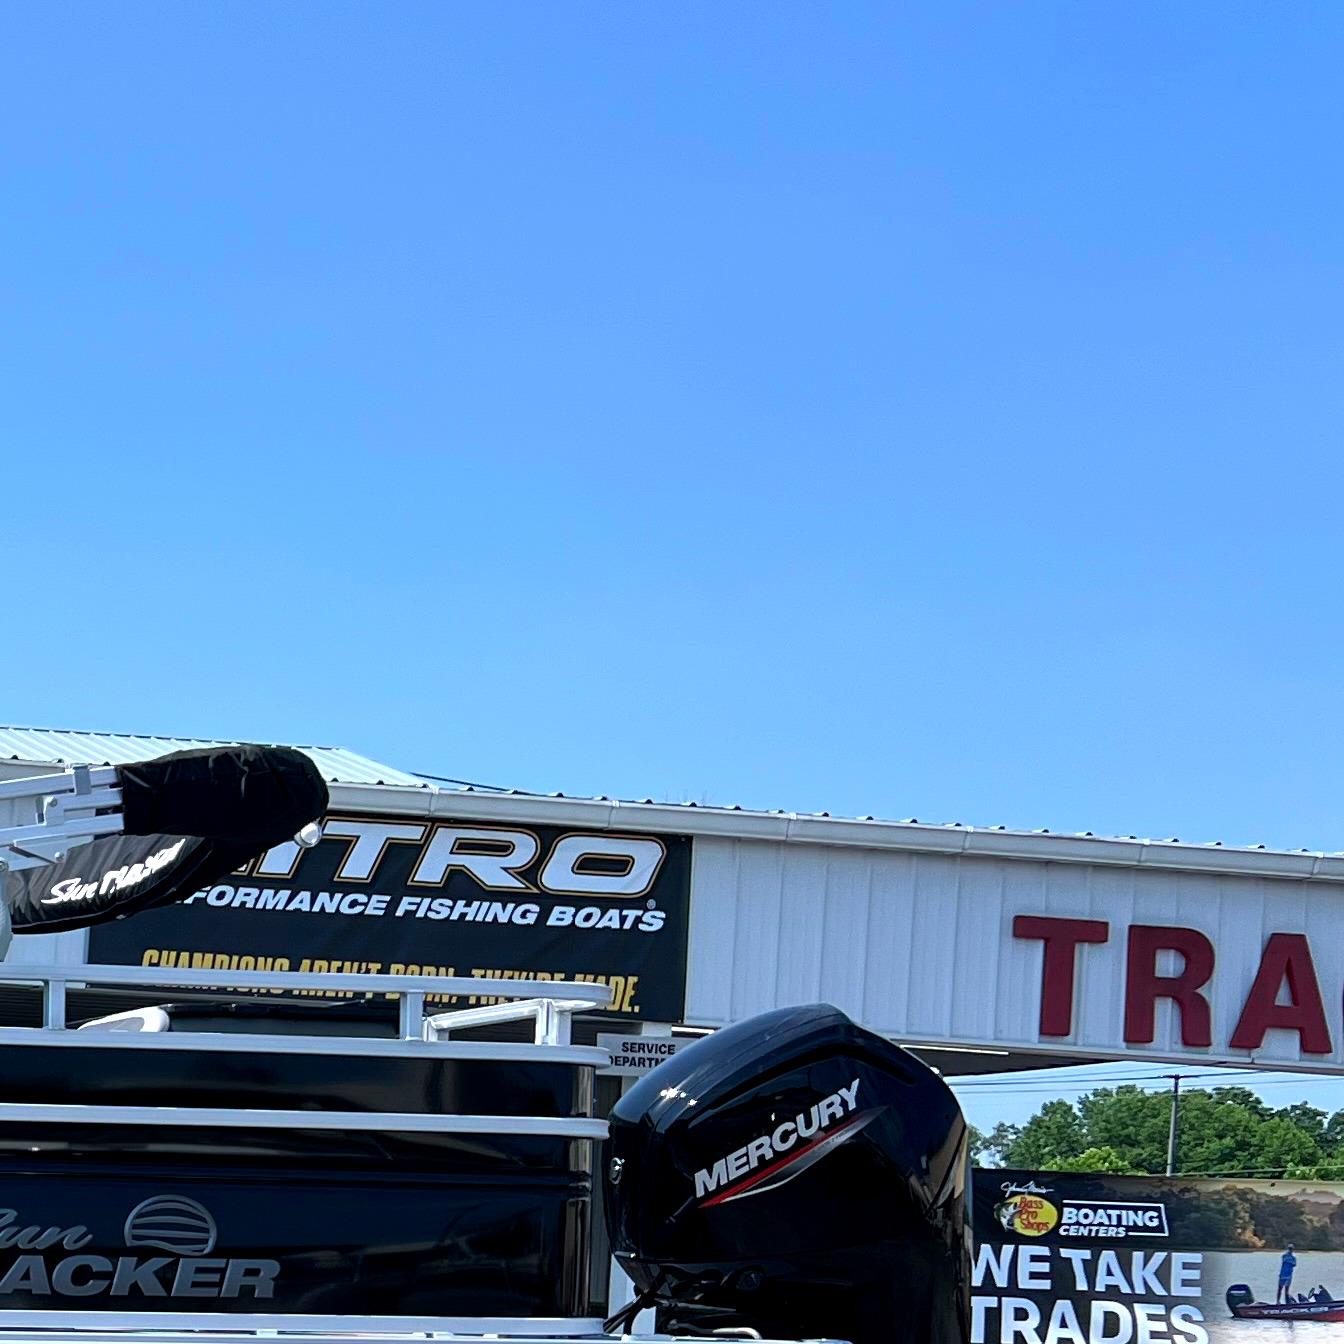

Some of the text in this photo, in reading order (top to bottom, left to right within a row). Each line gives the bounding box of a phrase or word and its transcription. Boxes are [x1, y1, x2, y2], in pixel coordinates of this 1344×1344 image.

[231, 816, 666, 898] ITRO
[176, 885, 666, 932] FORMANCE FISHING BOATS
[1013, 915, 1344, 1054] TRA
[609, 1055, 668, 1068] EPARTM
[621, 1042, 676, 1055] SERVICE
[694, 1078, 860, 1198] MERCURY
[1059, 1226, 1127, 1237] CENTERS
[1061, 1207, 1160, 1227] BOATING
[971, 1243, 1203, 1296] WE TAKE
